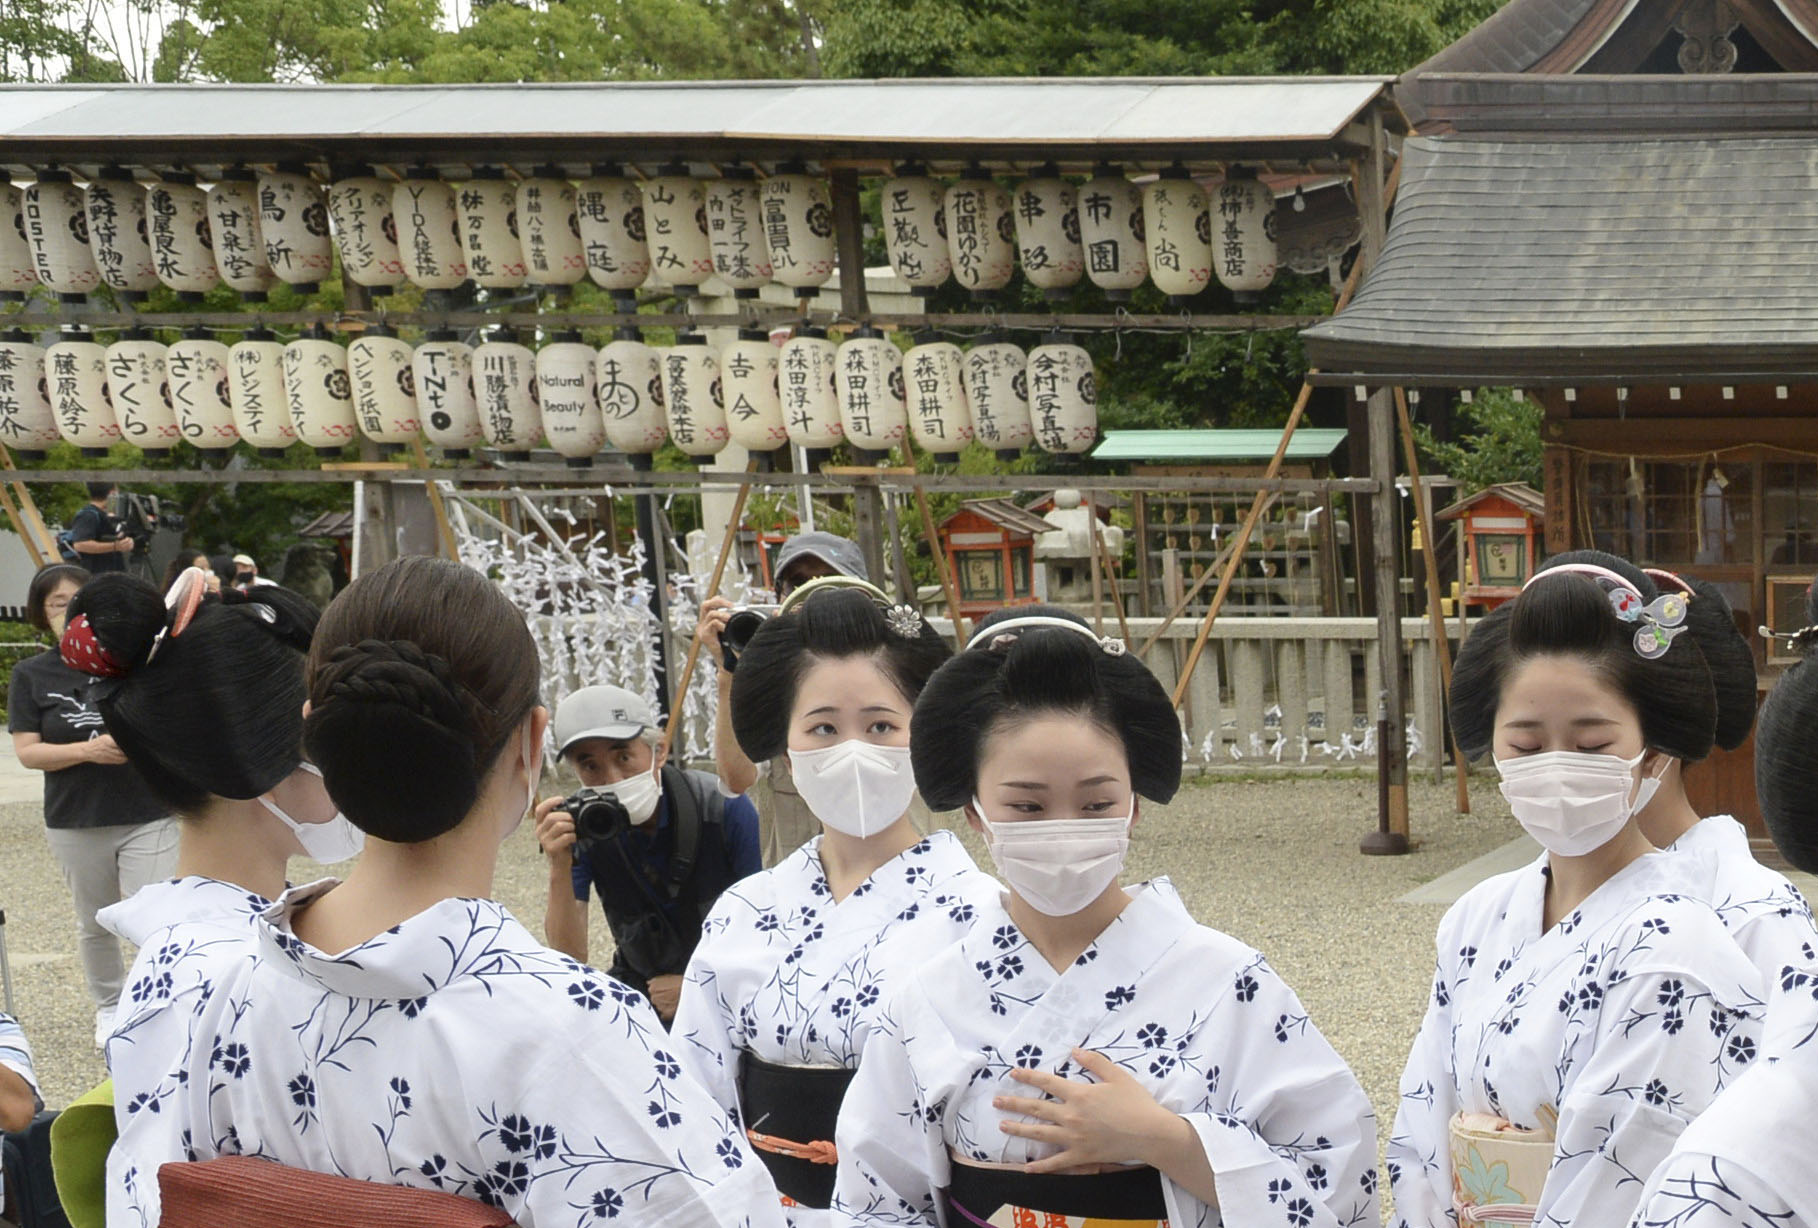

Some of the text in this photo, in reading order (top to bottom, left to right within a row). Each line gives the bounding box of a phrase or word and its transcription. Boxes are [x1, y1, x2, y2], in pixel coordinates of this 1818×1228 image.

[26, 189, 54, 283] NOSTER
[152, 189, 189, 279] 亀屋良永
[259, 185, 294, 270] 鳥新
[650, 185, 686, 270] 山とみ
[952, 191, 981, 285] 花園ゆかり
[53, 352, 88, 436] 藤原鈴子
[109, 352, 148, 436] さくら
[169, 351, 204, 438] さくら
[540, 374, 584, 387] Natural
[544, 400, 585, 416] Beauty
[785, 345, 814, 433] 森田淳斗
[845, 348, 872, 437] 森田耕司
[913, 353, 945, 439] 森田耕司
[969, 353, 1001, 442] 今村写真場
[1033, 353, 1069, 451] 今村写真場
